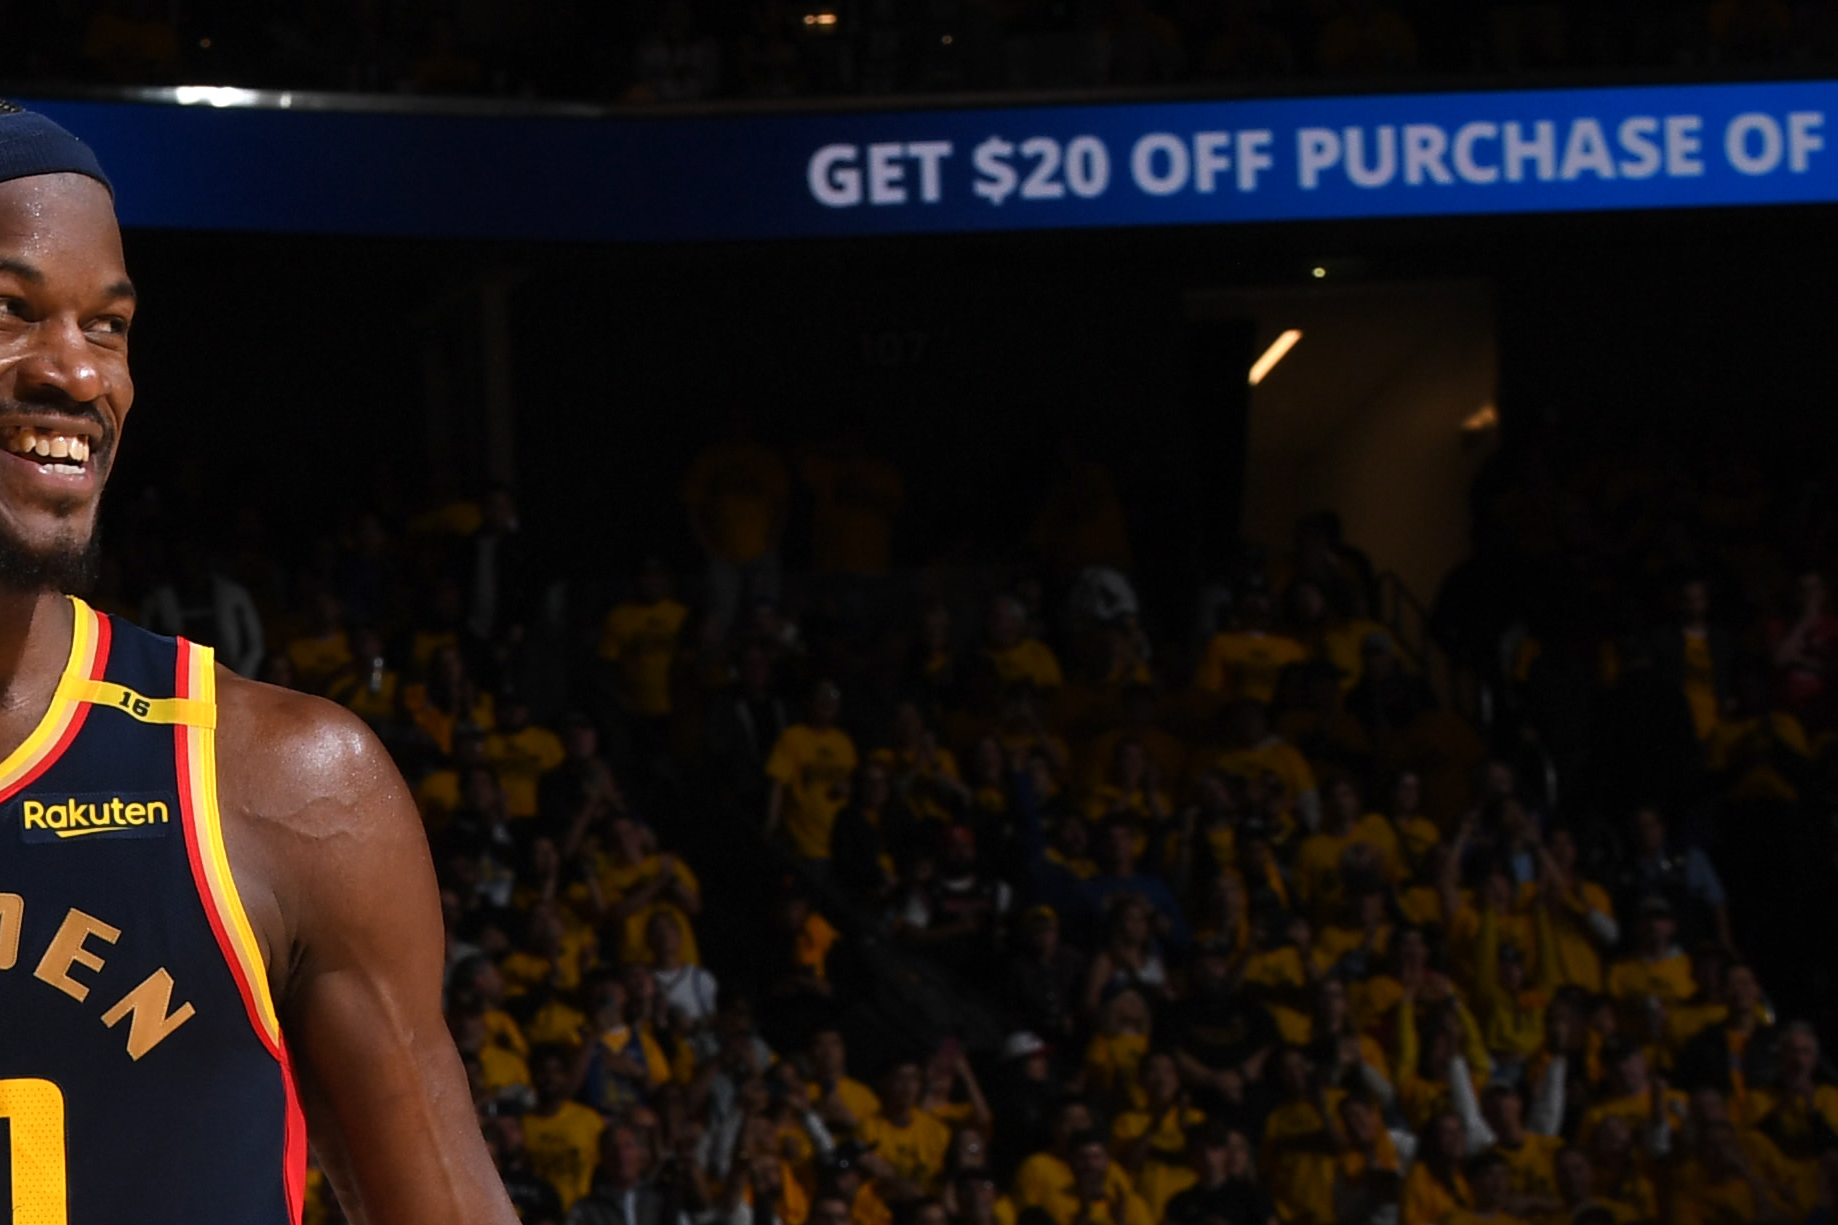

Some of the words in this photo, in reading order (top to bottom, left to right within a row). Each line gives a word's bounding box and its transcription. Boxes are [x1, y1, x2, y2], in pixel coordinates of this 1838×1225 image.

[807, 139, 954, 208] GET
[972, 134, 1110, 205] $20
[1130, 127, 1273, 197] OFF
[1297, 113, 1704, 190] PURCHASE
[1724, 109, 1824, 175] OF
[117, 690, 152, 717] 16
[22, 796, 170, 839] Rakuten
